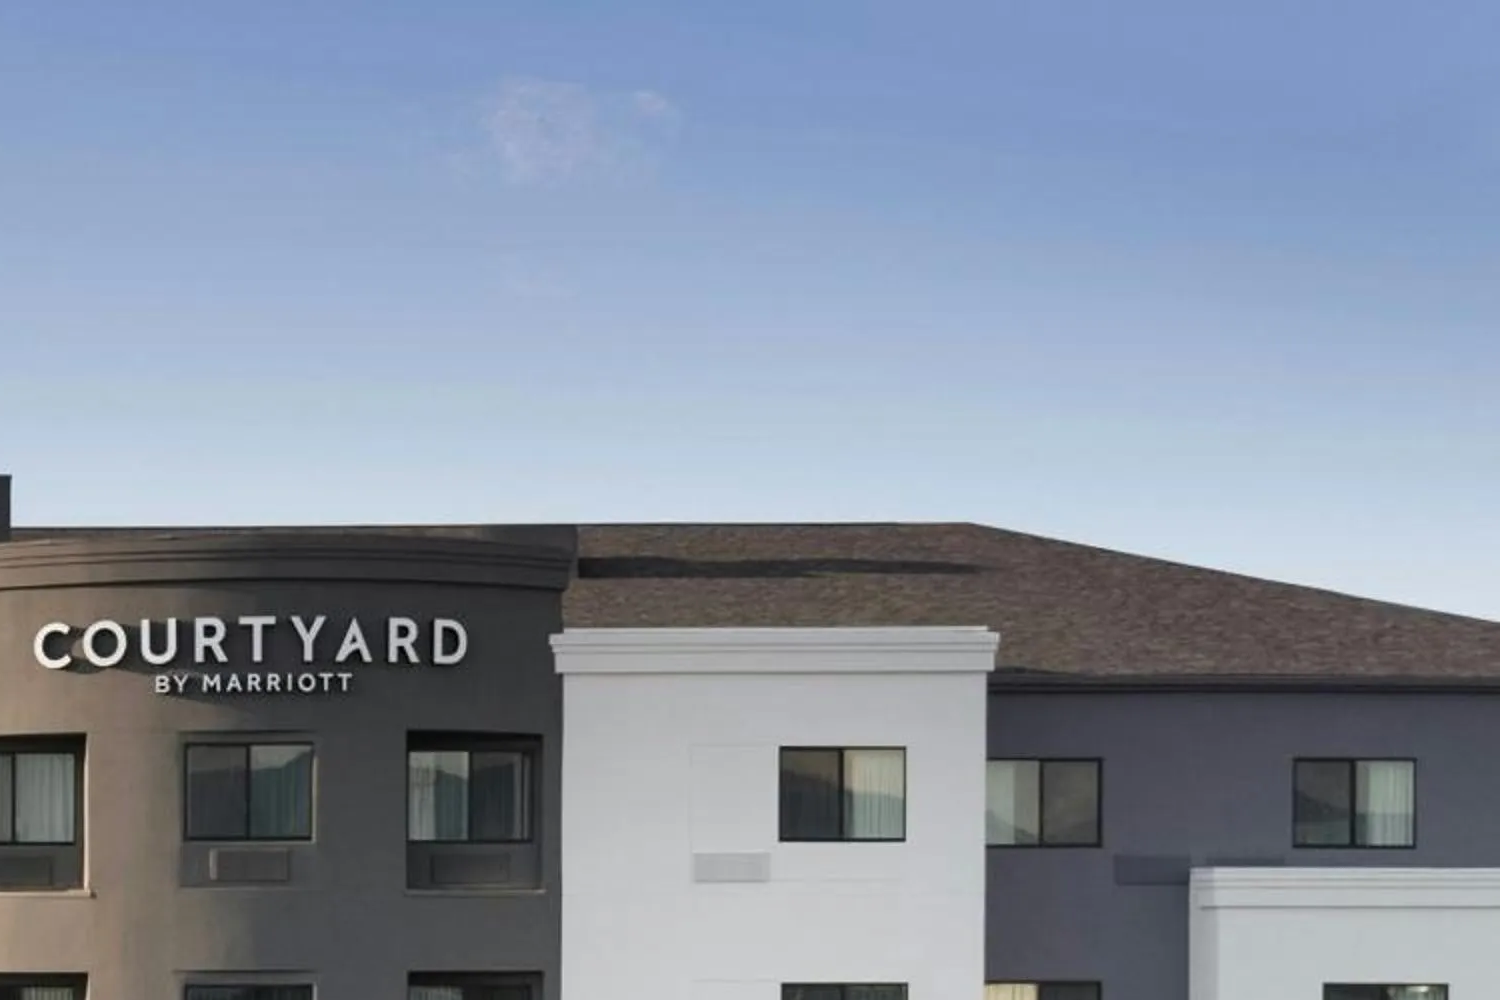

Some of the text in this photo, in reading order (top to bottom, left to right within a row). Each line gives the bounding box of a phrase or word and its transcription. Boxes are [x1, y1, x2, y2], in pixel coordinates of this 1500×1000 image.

[33, 615, 468, 669] COURTYARD
[154, 672, 354, 694] BY MARRIOTT
